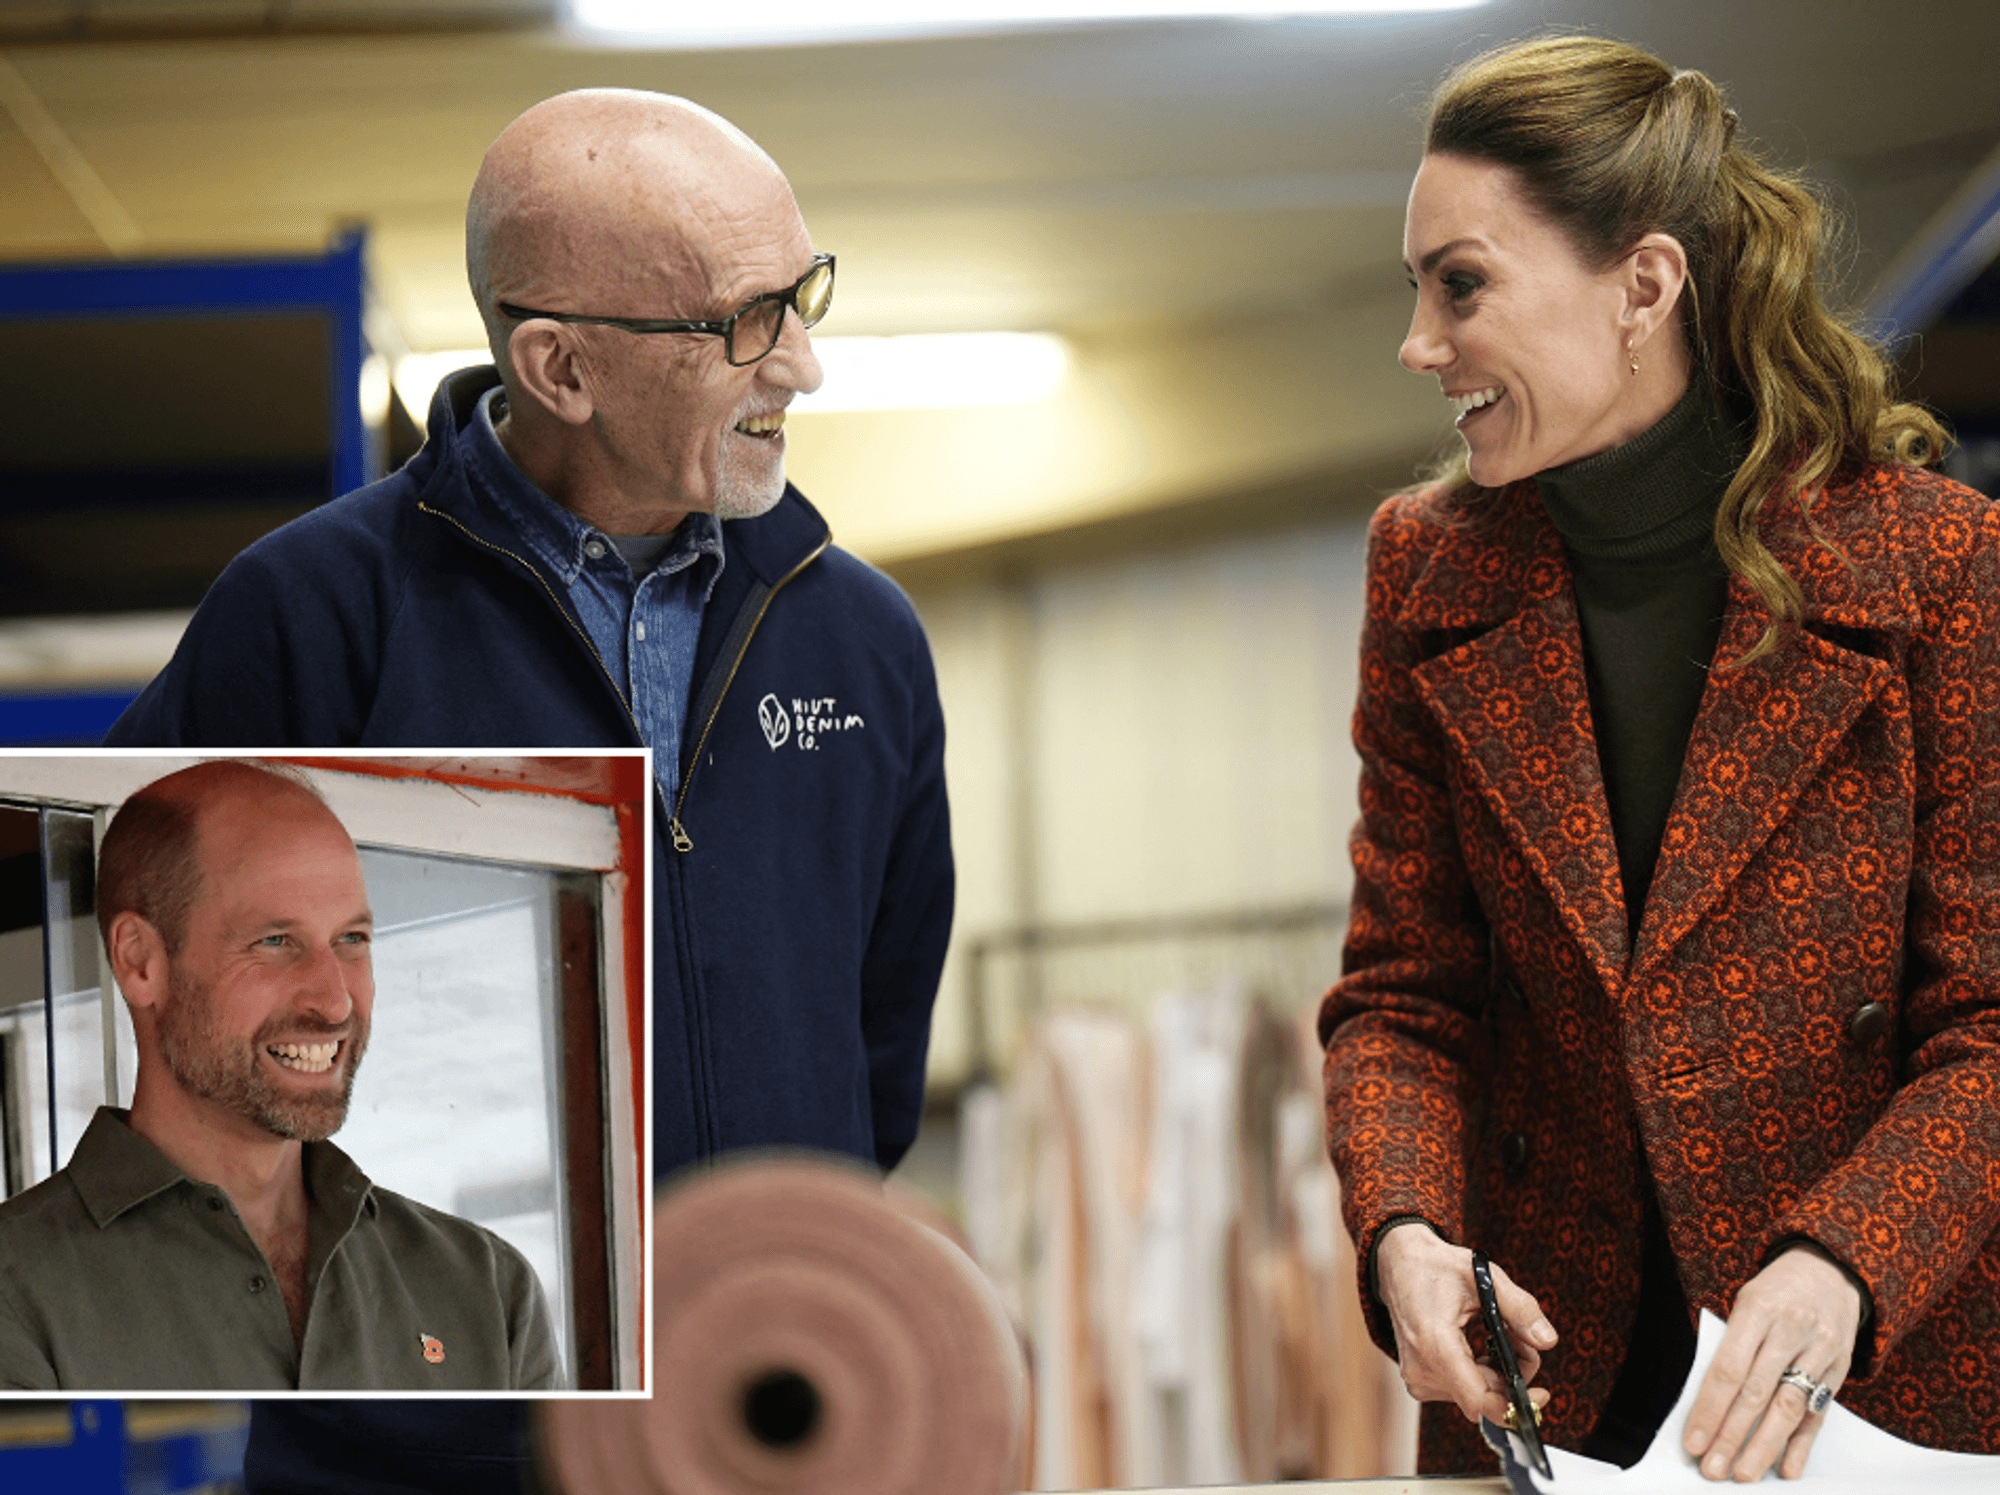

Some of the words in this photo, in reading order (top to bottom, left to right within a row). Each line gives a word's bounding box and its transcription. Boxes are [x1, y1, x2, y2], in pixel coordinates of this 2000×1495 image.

[791, 697, 836, 715] HIUT
[795, 714, 865, 734] DENIM
[797, 732, 820, 751] CO.
